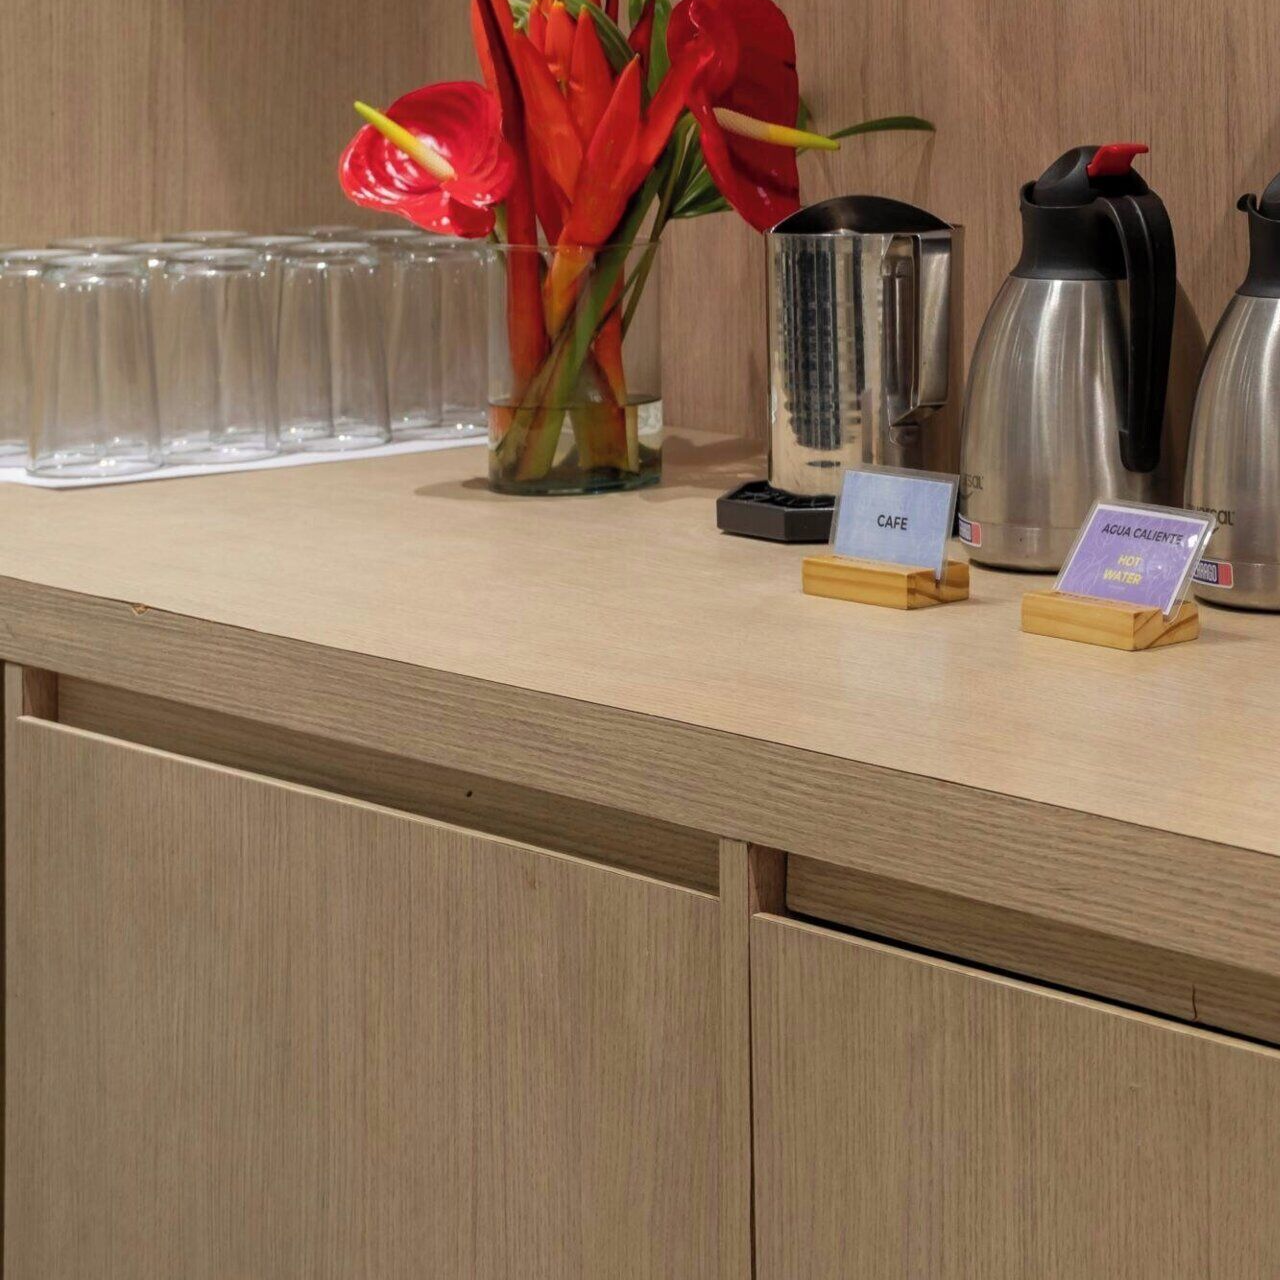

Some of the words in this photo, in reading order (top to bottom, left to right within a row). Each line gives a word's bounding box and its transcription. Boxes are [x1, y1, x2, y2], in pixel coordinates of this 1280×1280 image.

[877, 514, 909, 531] CAFE
[1101, 522, 1131, 537] AGUA
[1133, 527, 1185, 545] CALIENTE
[1117, 554, 1143, 567] HOT
[1103, 568, 1143, 585] WATER
